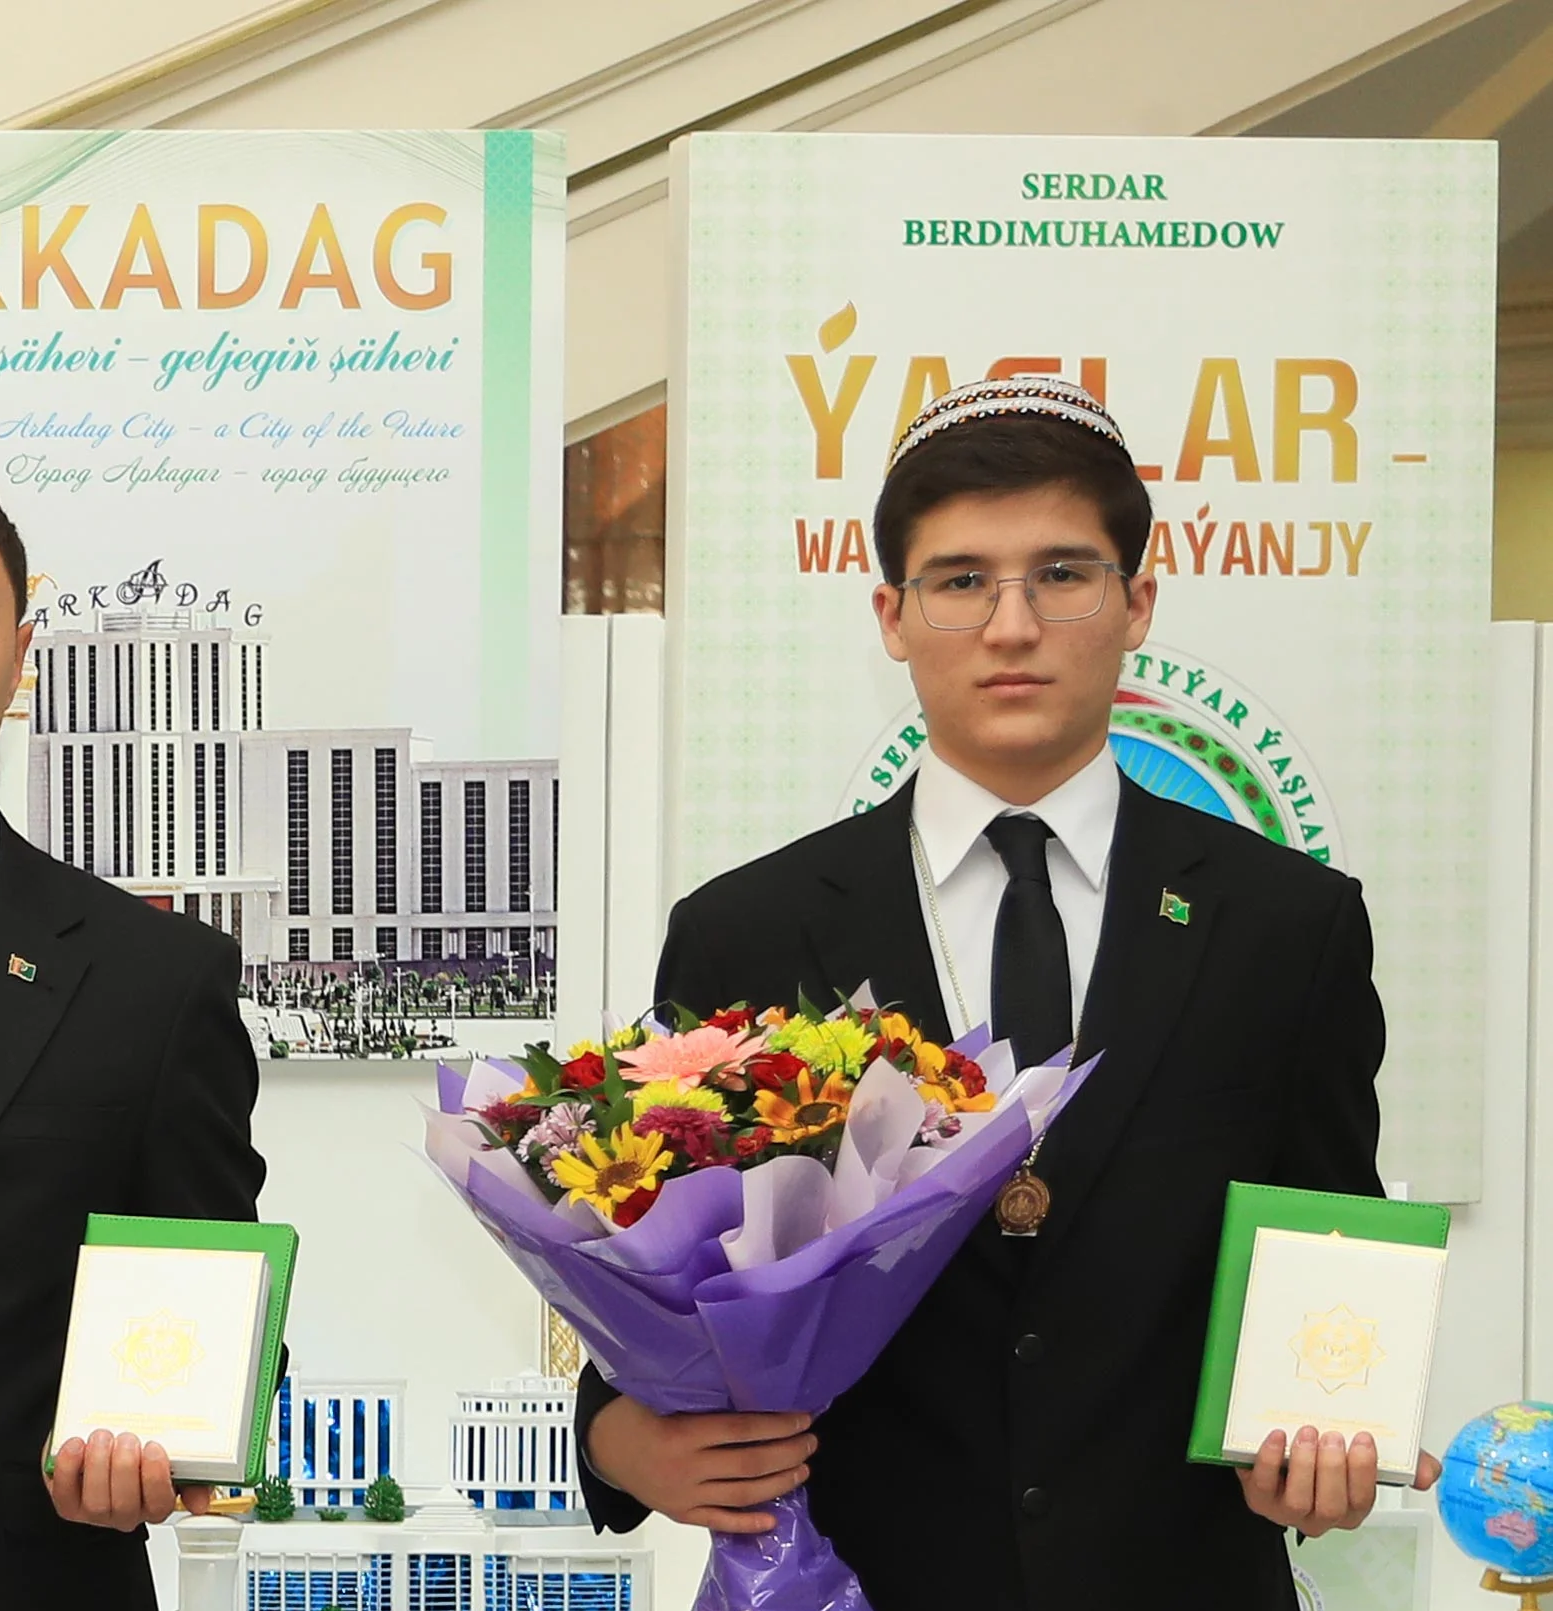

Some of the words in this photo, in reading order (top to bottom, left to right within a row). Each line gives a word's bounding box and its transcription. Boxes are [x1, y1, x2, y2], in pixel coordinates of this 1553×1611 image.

[1021, 172, 1169, 201] SERDAR
[902, 218, 1286, 249] BERDIMUHAMEDOW
[153, 330, 321, 393] geljegiň
[121, 412, 176, 449] City
[213, 423, 230, 438] a
[238, 412, 293, 449] City
[301, 412, 332, 449] of
[336, 411, 374, 439] the
[382, 409, 467, 440] Future
[5, 452, 93, 493] Город
[337, 456, 451, 493] будущего
[1146, 502, 1373, 577] AÝANJY
